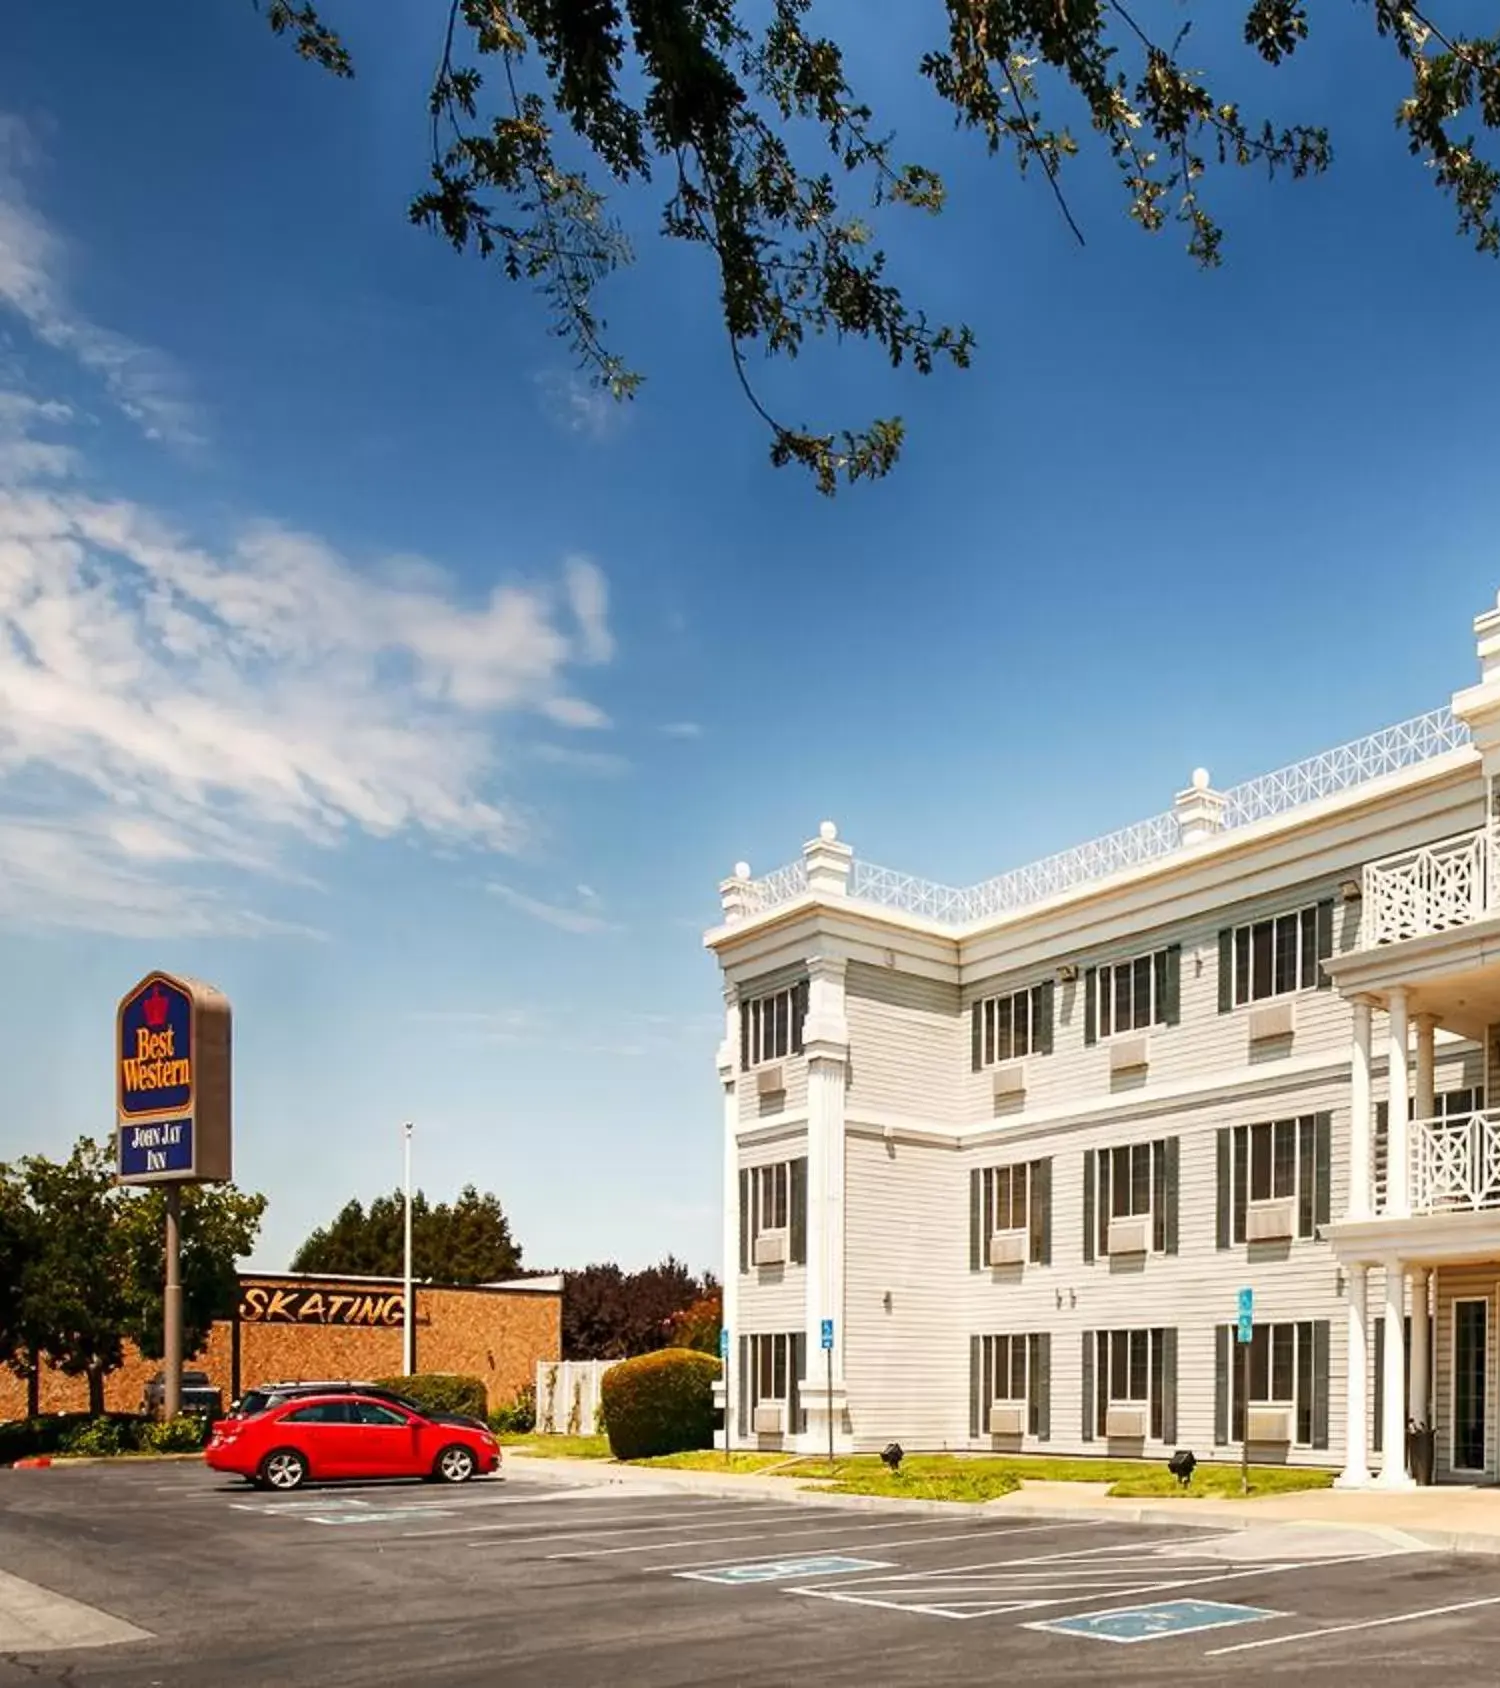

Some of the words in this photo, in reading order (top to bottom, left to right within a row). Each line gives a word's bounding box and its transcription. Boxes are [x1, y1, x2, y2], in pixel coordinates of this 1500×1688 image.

[136, 1024, 175, 1060] Best
[124, 1059, 191, 1091] Western
[239, 1288, 405, 1325] SKATING
